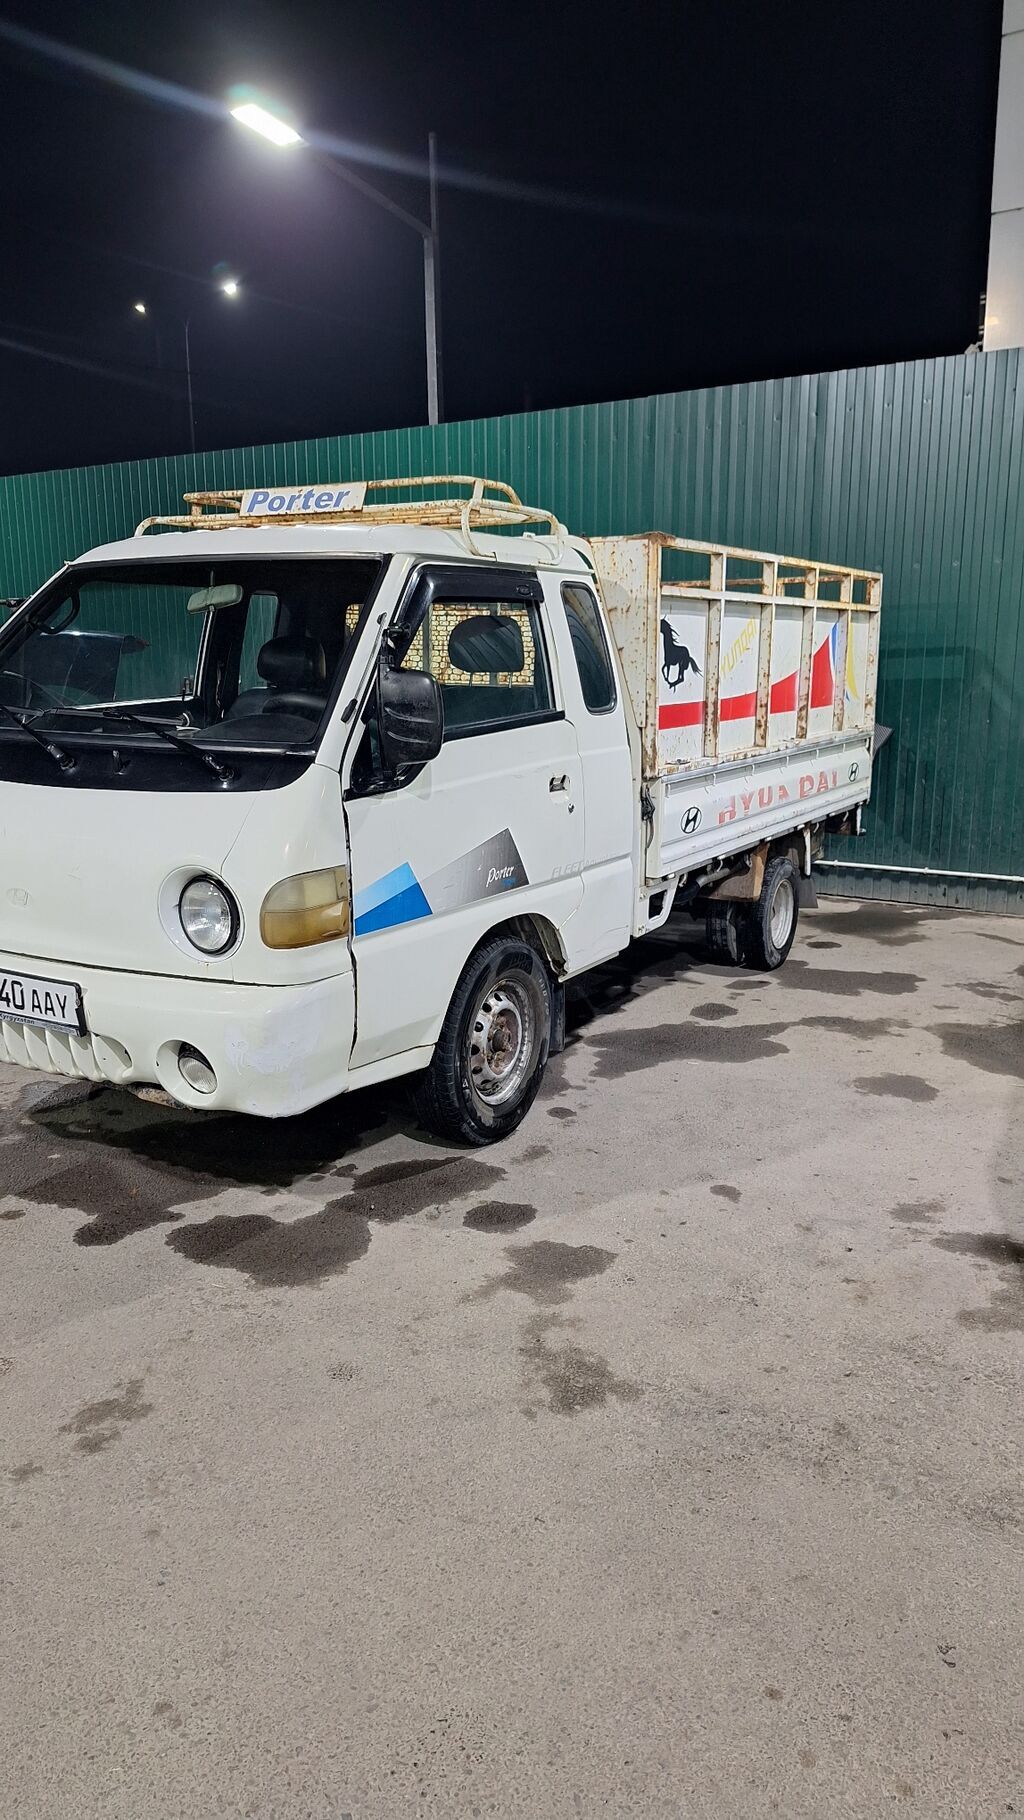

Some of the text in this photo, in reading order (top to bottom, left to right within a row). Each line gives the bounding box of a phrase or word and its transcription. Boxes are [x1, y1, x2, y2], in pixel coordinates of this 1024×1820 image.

[247, 488, 350, 513] Porter
[486, 866, 514, 887] Porter
[31, 989, 67, 1018] AAY
